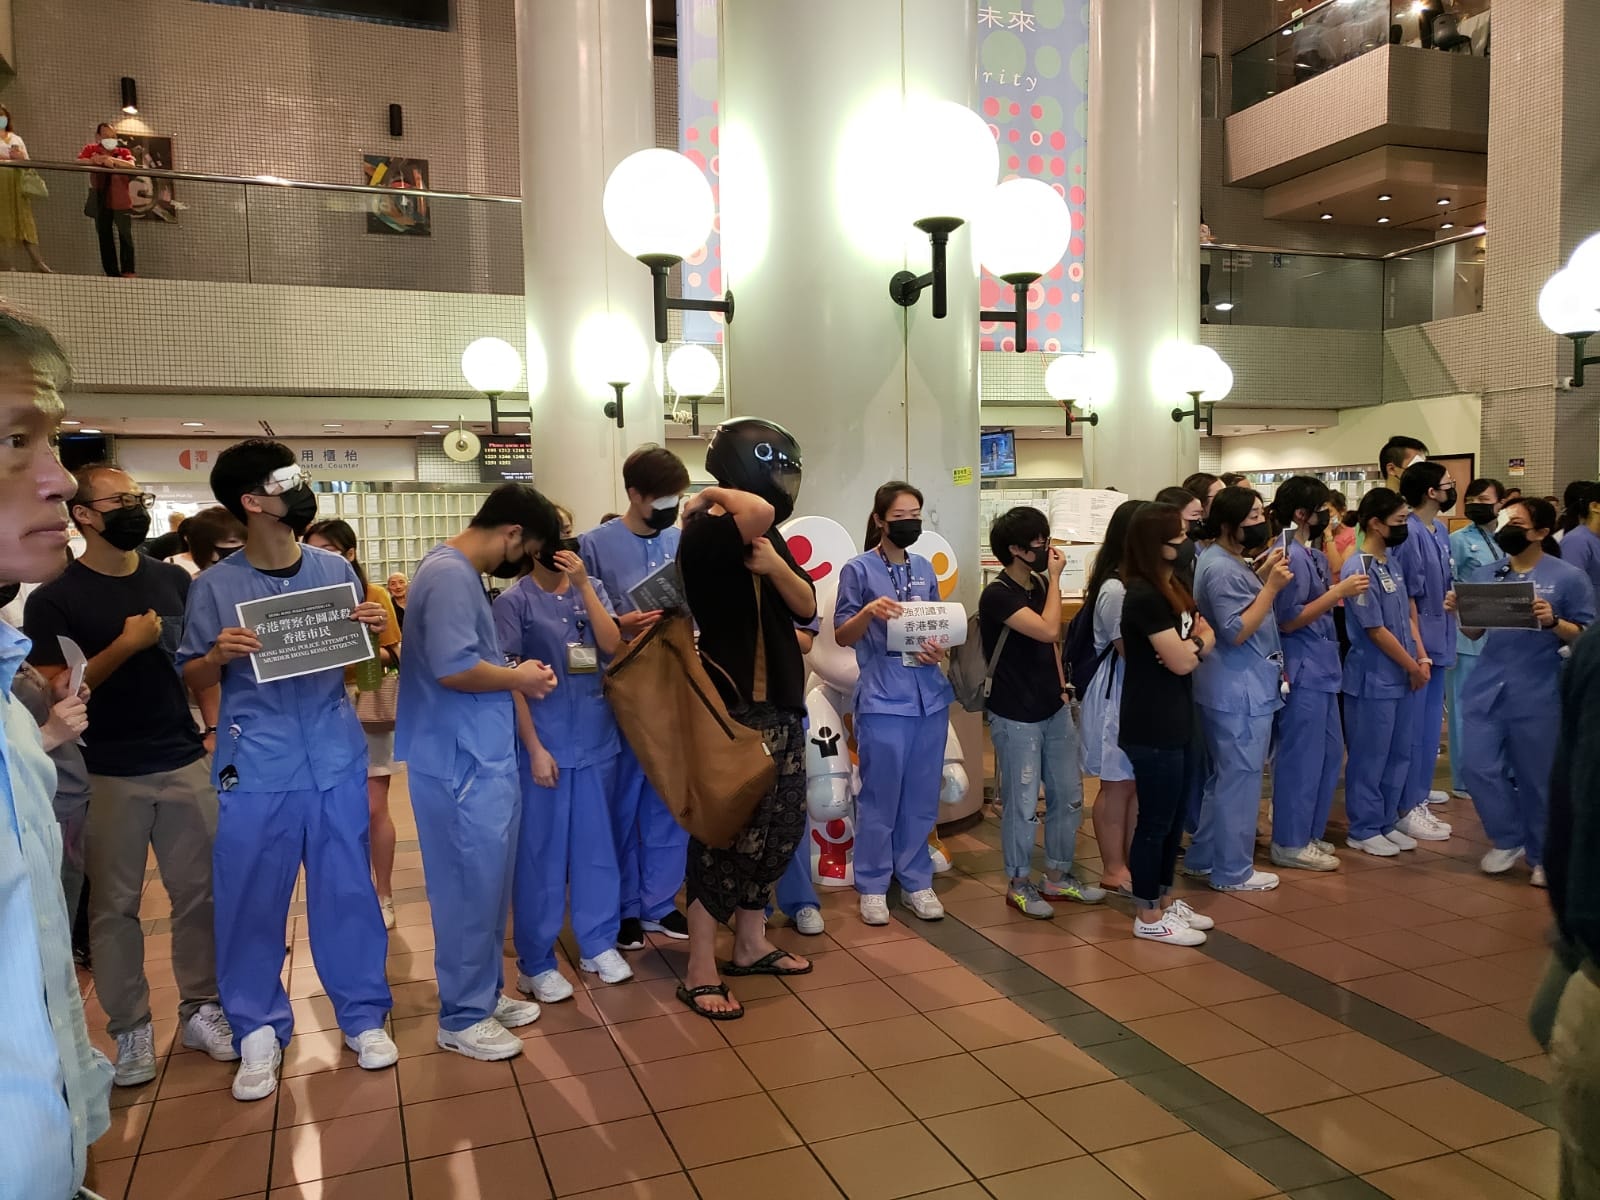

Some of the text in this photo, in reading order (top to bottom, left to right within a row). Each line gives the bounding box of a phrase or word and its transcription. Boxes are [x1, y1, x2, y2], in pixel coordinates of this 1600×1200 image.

[977, 6, 1036, 33] 未來
[979, 68, 1037, 92] rity
[255, 607, 352, 636] 香港警察企圖謀殺
[904, 619, 949, 632] 香港警察
[259, 632, 359, 658] HONG KONG POLICE ATTEMPT TO
[283, 625, 332, 645] 香港市民
[263, 653, 290, 664] MURDER
[290, 650, 310, 660] HONG
[310, 647, 328, 657] KONG
